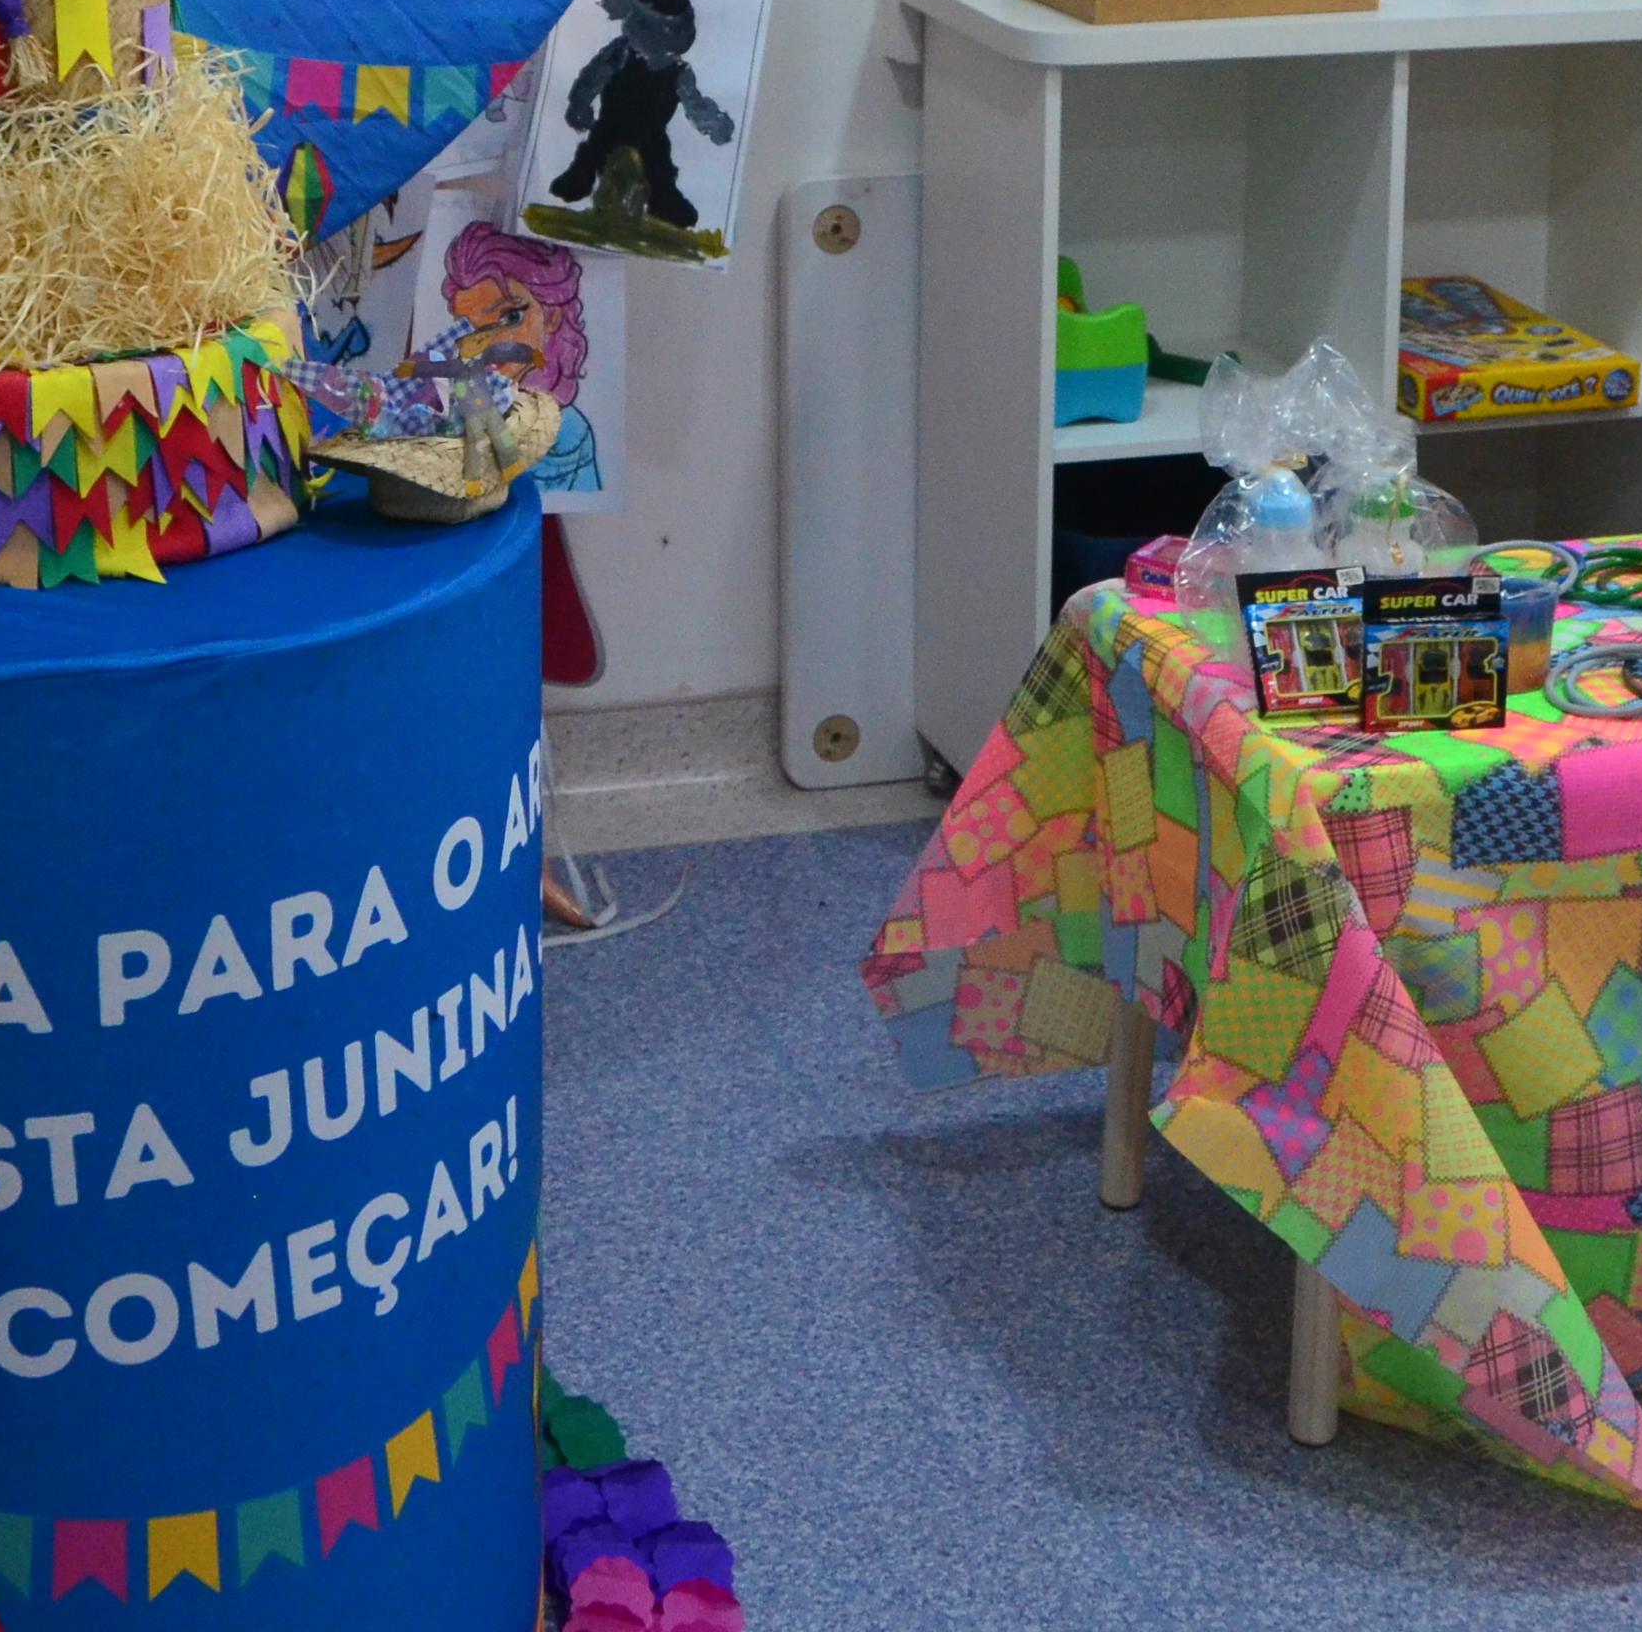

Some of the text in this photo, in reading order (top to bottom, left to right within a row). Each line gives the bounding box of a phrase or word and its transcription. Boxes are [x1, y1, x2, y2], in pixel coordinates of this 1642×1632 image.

[1255, 585, 1349, 604] SUPER CAR
[1379, 593, 1479, 610] SUPER CAR
[97, 865, 408, 1027] PARA
[433, 816, 483, 911] O
[229, 924, 533, 1169] JUNINA
